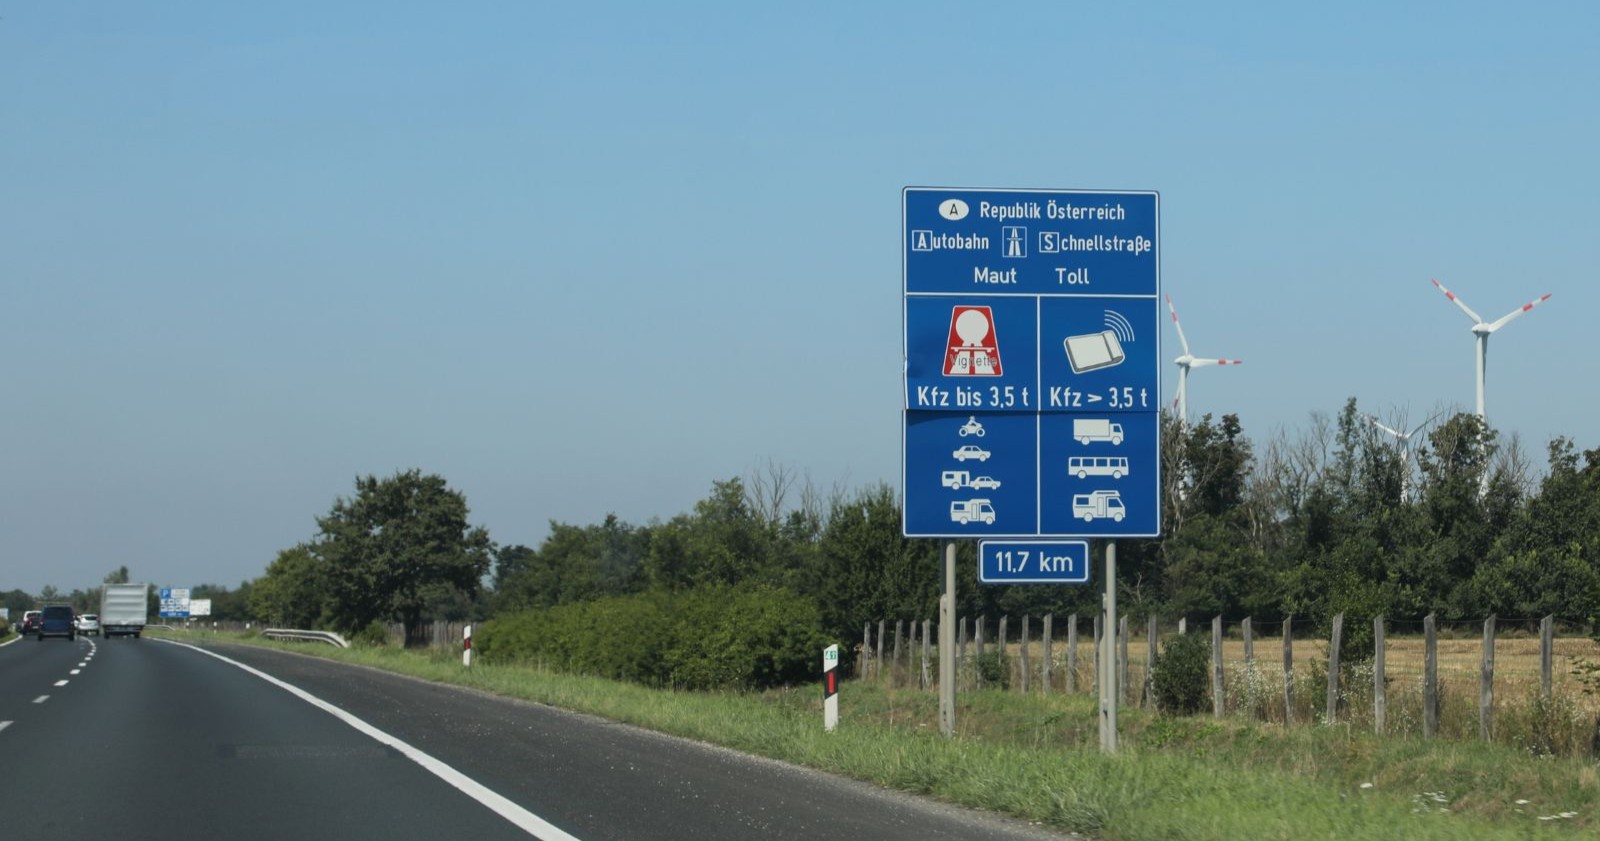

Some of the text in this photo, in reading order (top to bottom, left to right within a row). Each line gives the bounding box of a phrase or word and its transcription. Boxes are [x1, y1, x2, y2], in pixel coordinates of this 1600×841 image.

[949, 199, 1125, 222] A Republik Österreich
[915, 230, 990, 252] Autobahn
[1042, 232, 1152, 256] Schnellstraße
[975, 267, 1016, 283] Maut
[1056, 268, 1089, 284] Toll
[949, 353, 998, 369] Vignette
[917, 386, 1029, 407] Kfz bis 3,5 t
[1050, 386, 1082, 407] Kfz
[1109, 387, 1134, 408] 3,5
[1140, 388, 1148, 407] t
[996, 552, 1072, 572] 11,7 km
